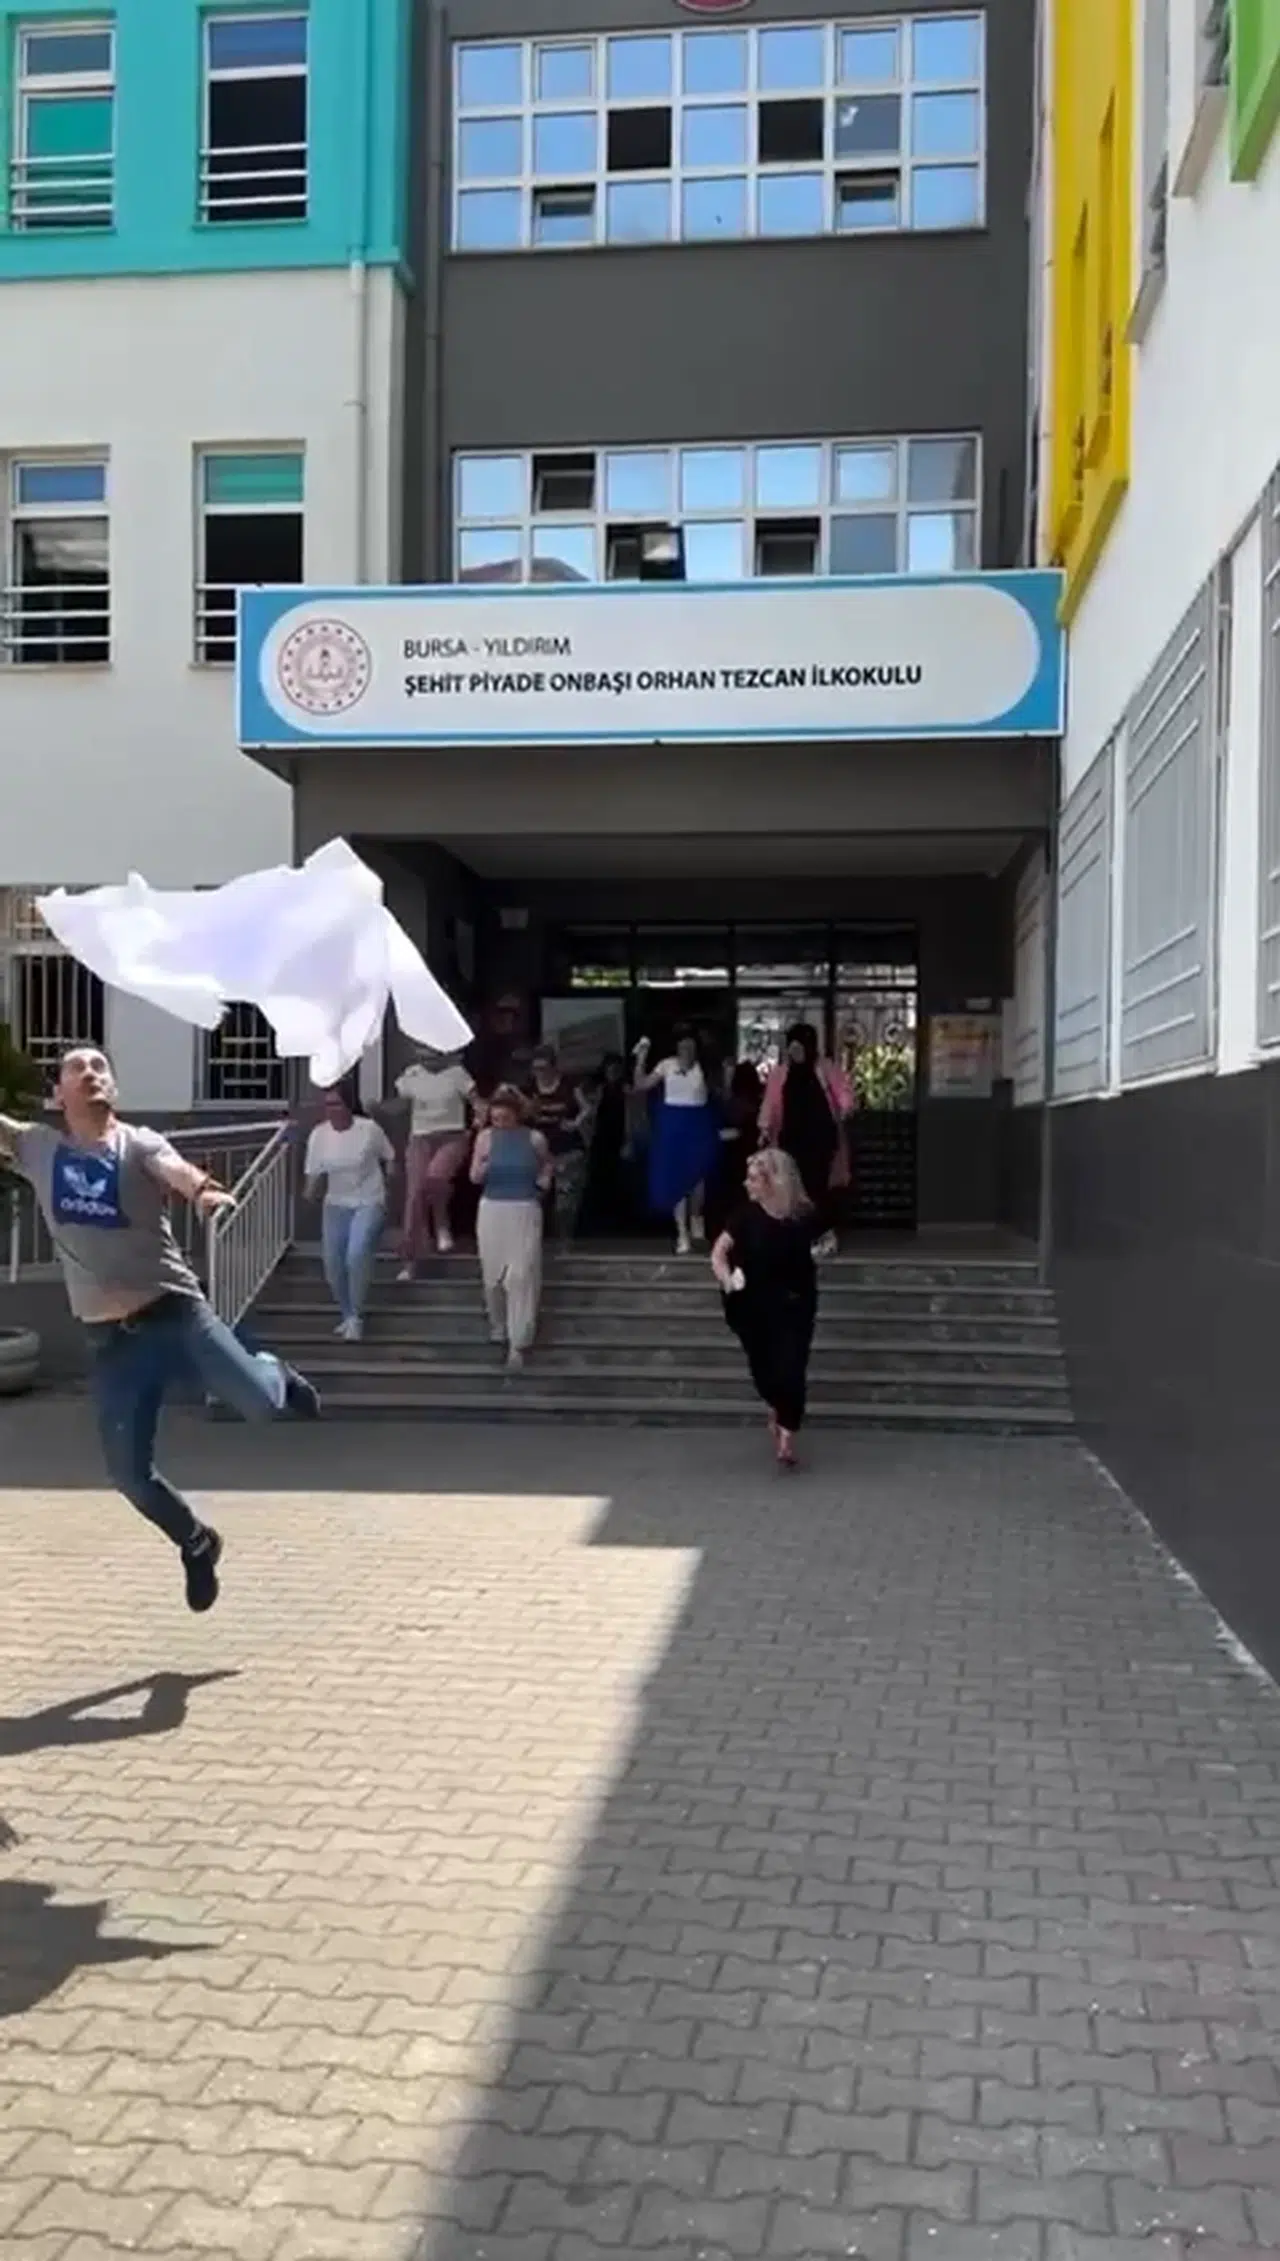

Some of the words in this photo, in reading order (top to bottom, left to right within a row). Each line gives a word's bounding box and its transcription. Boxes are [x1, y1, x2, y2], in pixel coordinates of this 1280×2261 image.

[404, 638, 468, 658] BURSA
[483, 637, 571, 657] YILDIRIM
[405, 673, 465, 697] ŞEHİT
[469, 670, 545, 693] PİYADE
[550, 671, 631, 695] ONBAŞI
[636, 670, 715, 690] ORHAN
[719, 668, 806, 688] TEZCAN
[812, 664, 921, 686] İLKOKULU
